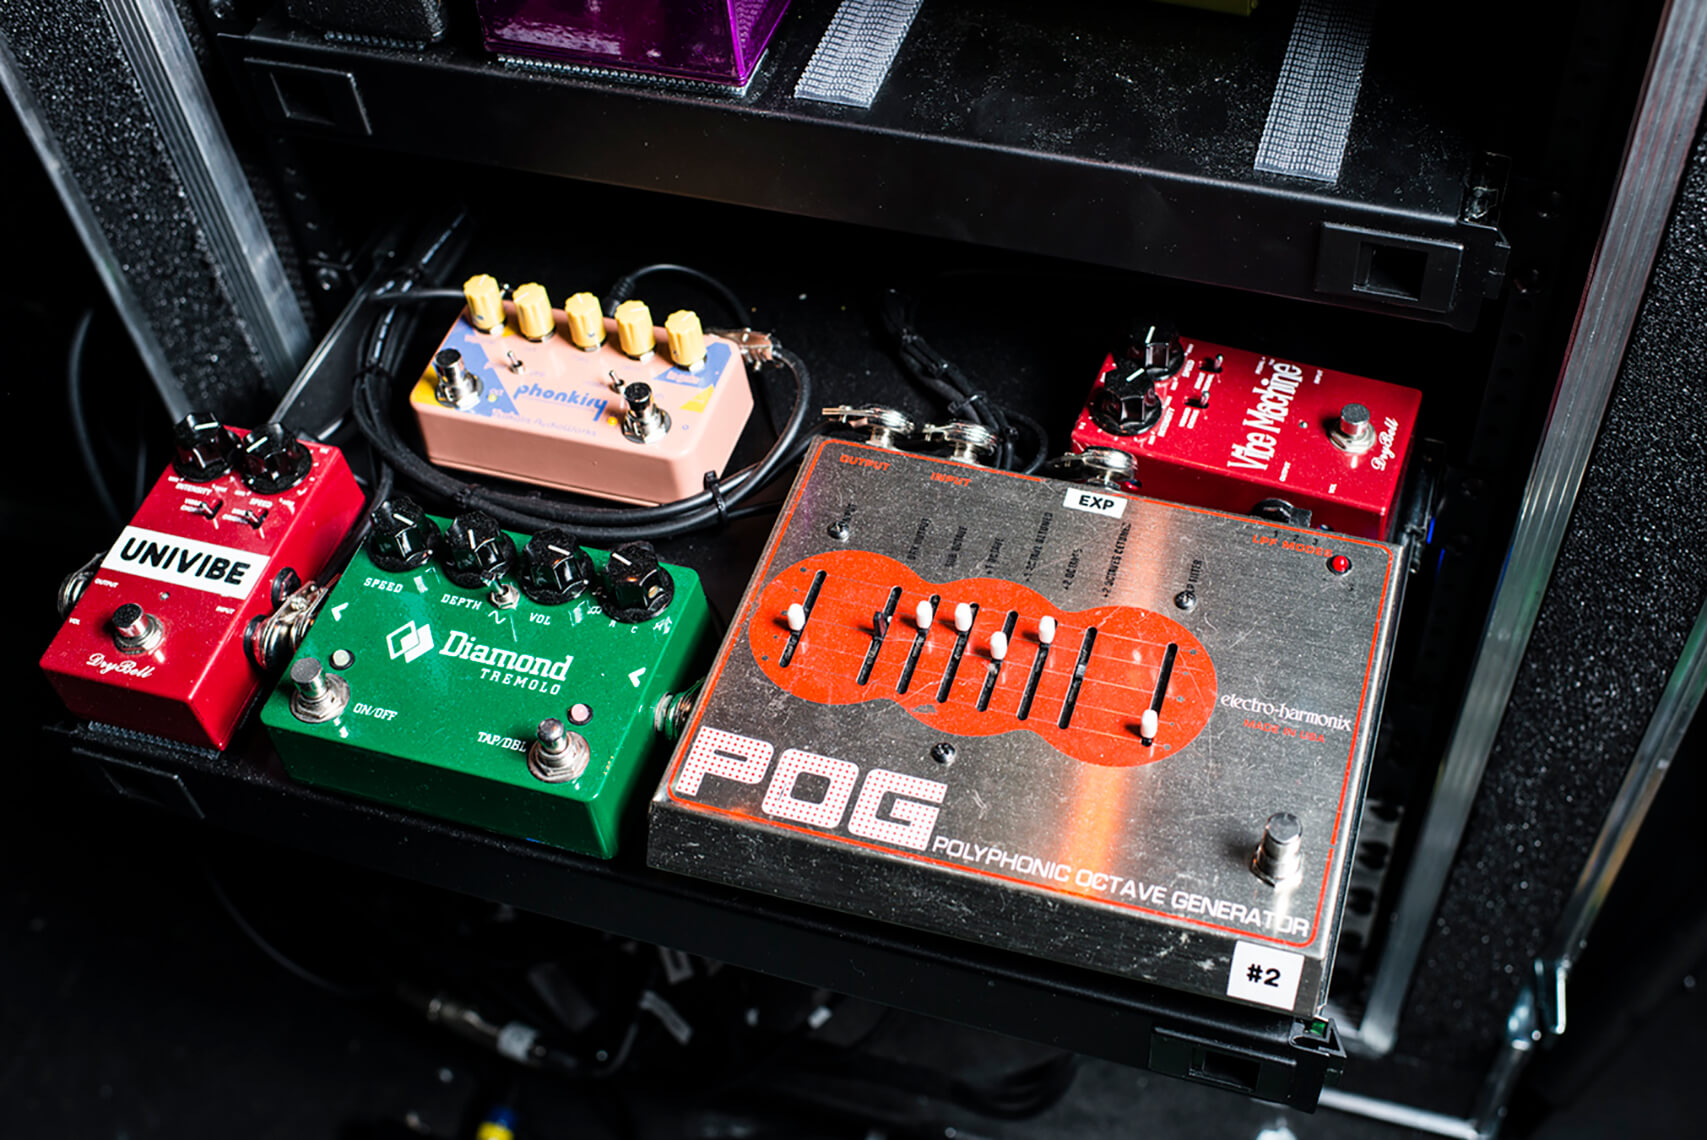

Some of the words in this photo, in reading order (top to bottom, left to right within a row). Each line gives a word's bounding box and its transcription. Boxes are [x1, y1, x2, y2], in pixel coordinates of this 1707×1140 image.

[1242, 362, 1303, 435] Machine
[1226, 432, 1277, 471] Vibe
[1370, 417, 1399, 471] DryBell
[839, 454, 891, 471] OUTPUT
[930, 472, 972, 487] INPUT
[1078, 494, 1115, 511] EXP
[1252, 534, 1278, 547] LPF
[1281, 540, 1333, 558] MODES
[120, 536, 251, 586] UNIVIBE
[363, 577, 404, 594] SPEED
[441, 593, 482, 610] DEPTH
[529, 612, 551, 626] VOL
[86, 652, 155, 679] DryBell
[439, 630, 574, 681] Diamond
[480, 668, 561, 696] TREMOLO
[353, 702, 398, 721] ON/OFF
[1220, 693, 1352, 732] electro-harmonix
[477, 731, 528, 753] TAP/DBL
[1243, 718, 1280, 734] MADE
[1283, 726, 1296, 737] IN
[1299, 730, 1326, 744] USA
[675, 725, 948, 851] POG
[932, 835, 1072, 883] POLYPHONIC
[1075, 868, 1167, 904] OCTAVE
[1171, 890, 1311, 938] GENERATOR
[1246, 963, 1281, 988] #2
